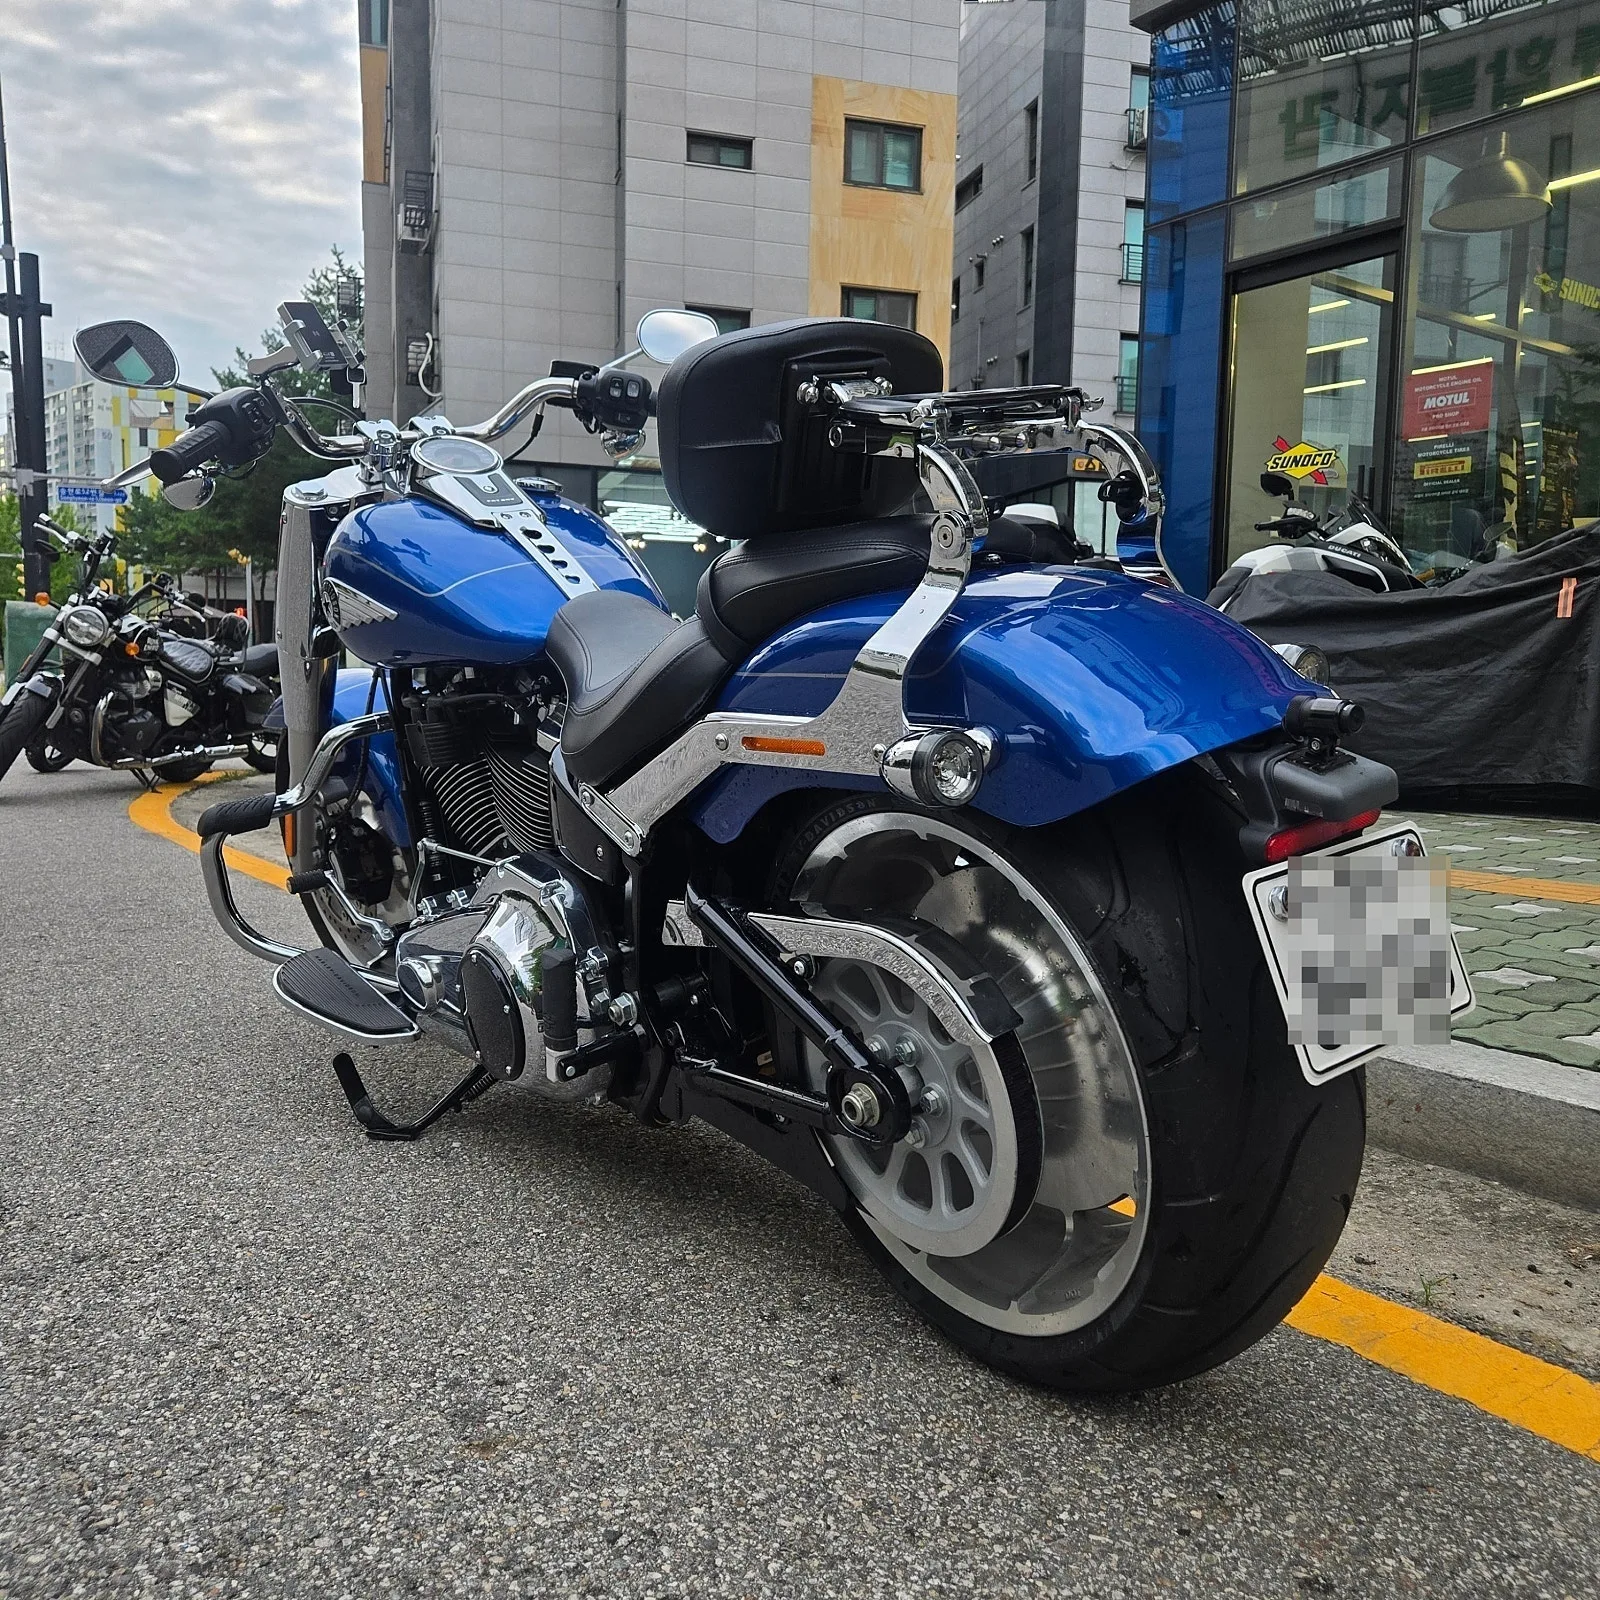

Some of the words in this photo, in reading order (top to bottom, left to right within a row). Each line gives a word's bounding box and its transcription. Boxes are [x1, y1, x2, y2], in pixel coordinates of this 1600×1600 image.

[1415, 382, 1450, 392] MOTORCYCLE
[1451, 379, 1471, 387] ENGINE
[1423, 392, 1470, 410] MOTUL
[1434, 442, 1454, 450] PIRELLI
[1417, 449, 1453, 458] MOTORCYCLE
[1270, 453, 1333, 469] SUNOCO
[1419, 460, 1466, 475] PIRELLI
[1328, 545, 1361, 558] DUCATI
